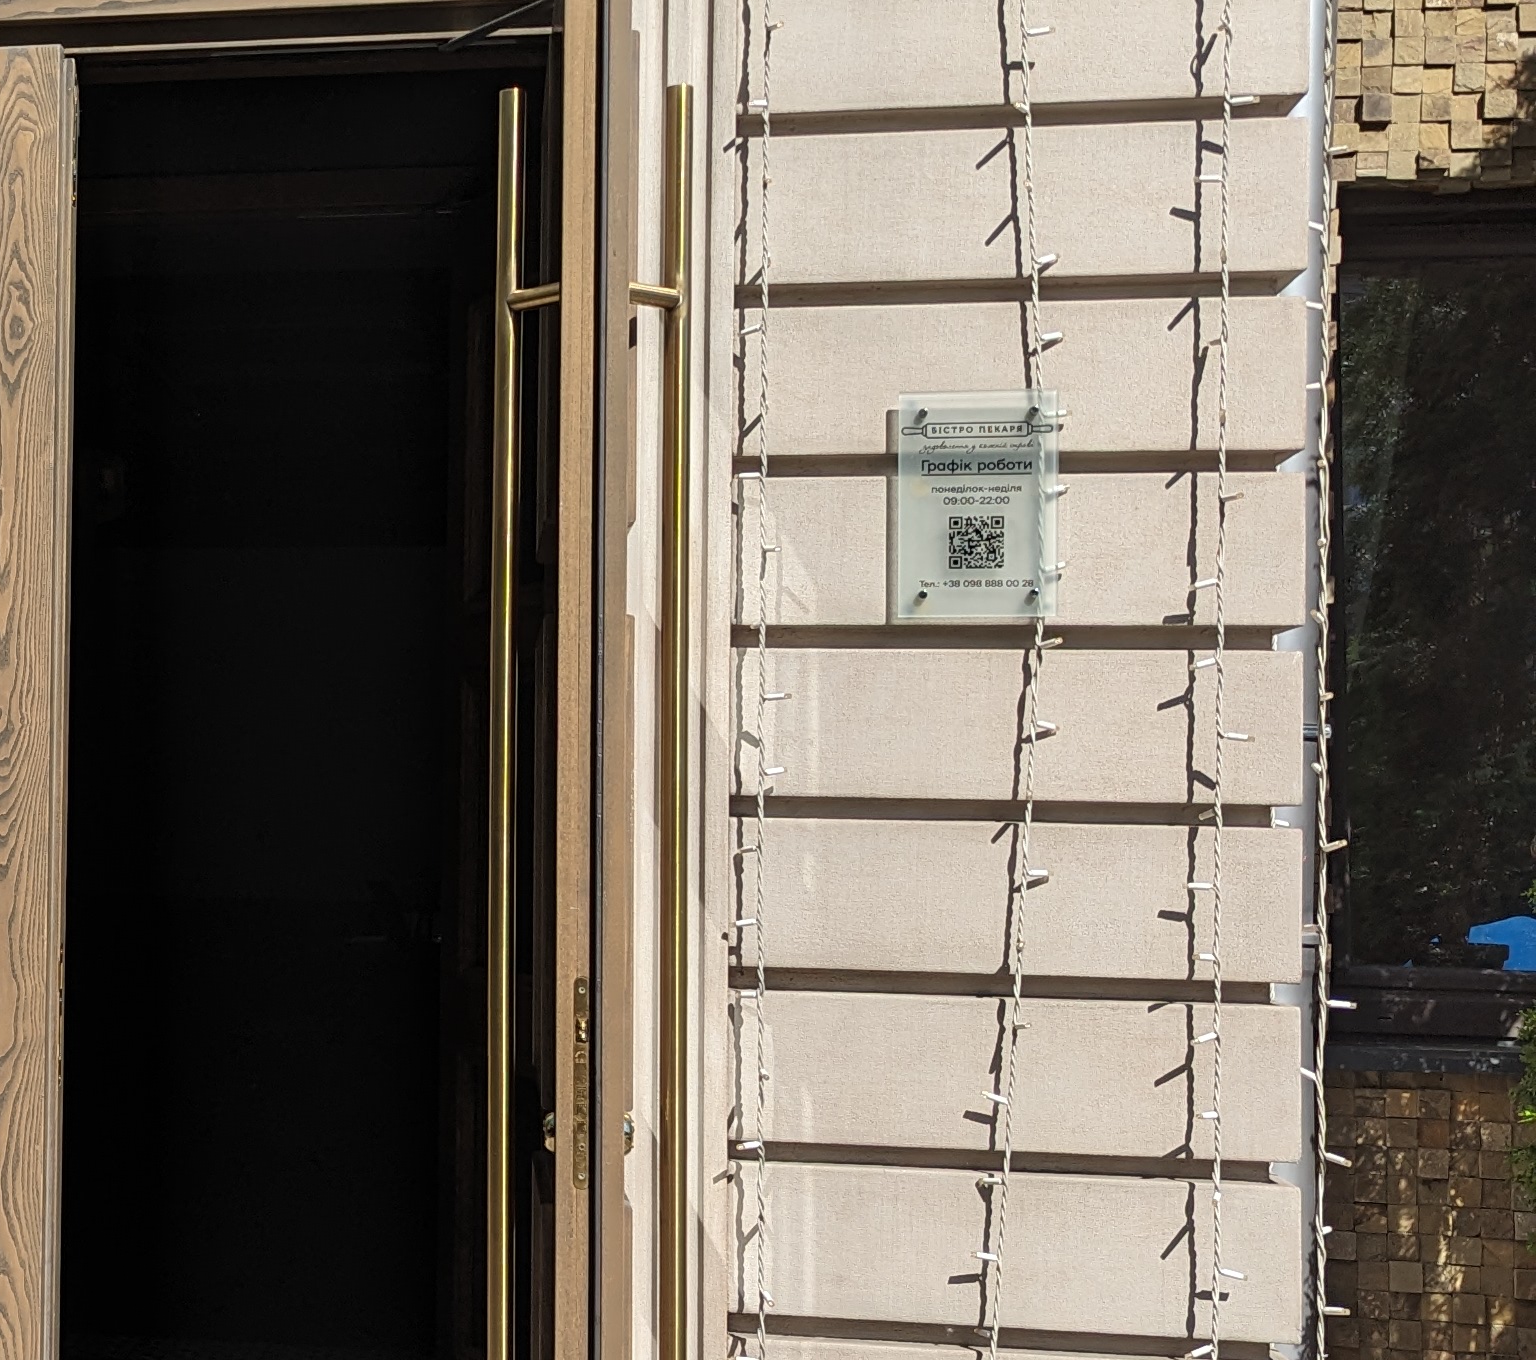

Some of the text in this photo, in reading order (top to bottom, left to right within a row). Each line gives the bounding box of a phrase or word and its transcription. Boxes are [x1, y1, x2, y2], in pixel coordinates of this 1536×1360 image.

[931, 424, 1023, 434] БІСТРО ПЕКАРЯ
[921, 457, 1032, 474] Графік роботи
[931, 483, 1022, 494] понеділок-неділя
[943, 495, 1010, 505] 09:00-22:00
[943, 579, 960, 588] +38
[1006, 579, 1019, 587] 00
